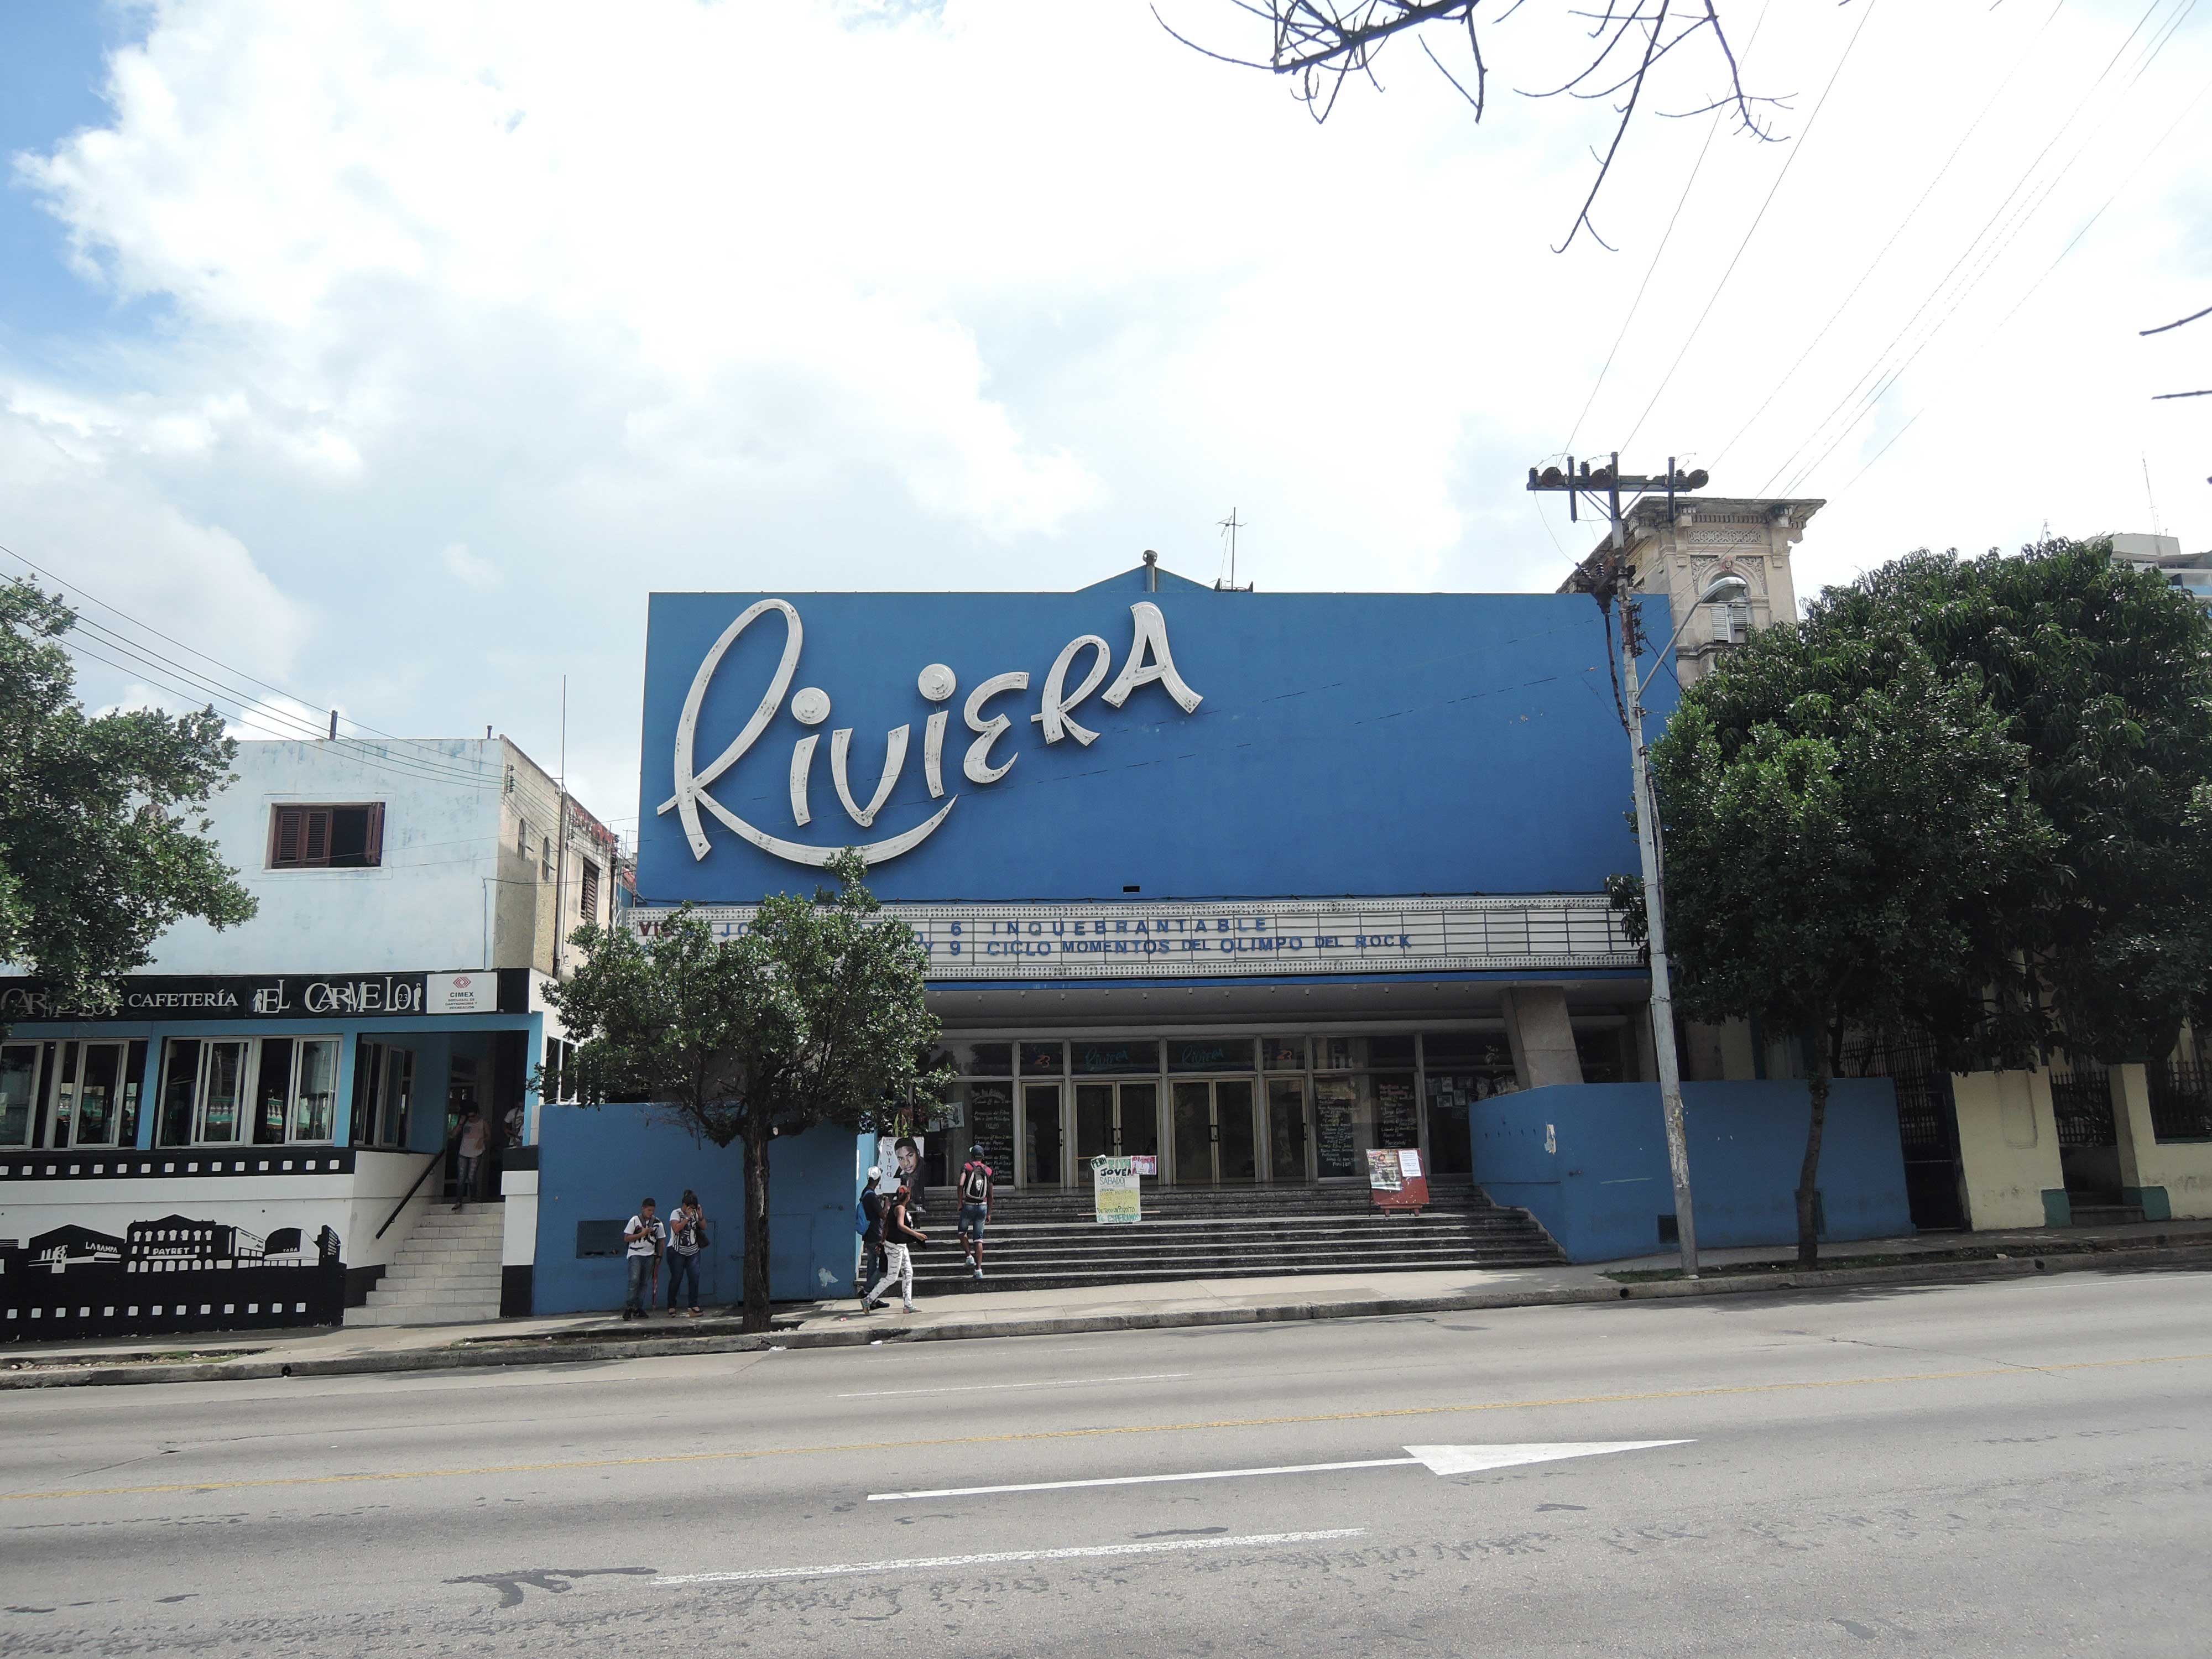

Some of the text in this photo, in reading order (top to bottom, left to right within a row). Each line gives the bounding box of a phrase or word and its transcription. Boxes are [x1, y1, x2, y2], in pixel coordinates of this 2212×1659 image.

[951, 921, 962, 936] 6
[992, 917, 1266, 936] INQUEBRANTABLE
[950, 941, 961, 956] 9
[987, 940, 1051, 956] CICLO
[1062, 939, 1170, 954] MOMENTOS
[1182, 938, 1211, 951] DEL
[1220, 936, 1302, 953] OLIMPO
[1315, 936, 1344, 948] DEL
[1355, 934, 1411, 949] ROCK
[128, 989, 239, 1007] CAFETERÍA
[259, 977, 411, 1013] EL CARMELO
[1100, 1168, 1134, 1177] JOVEN
[85, 1241, 118, 1253] LA RAMPA
